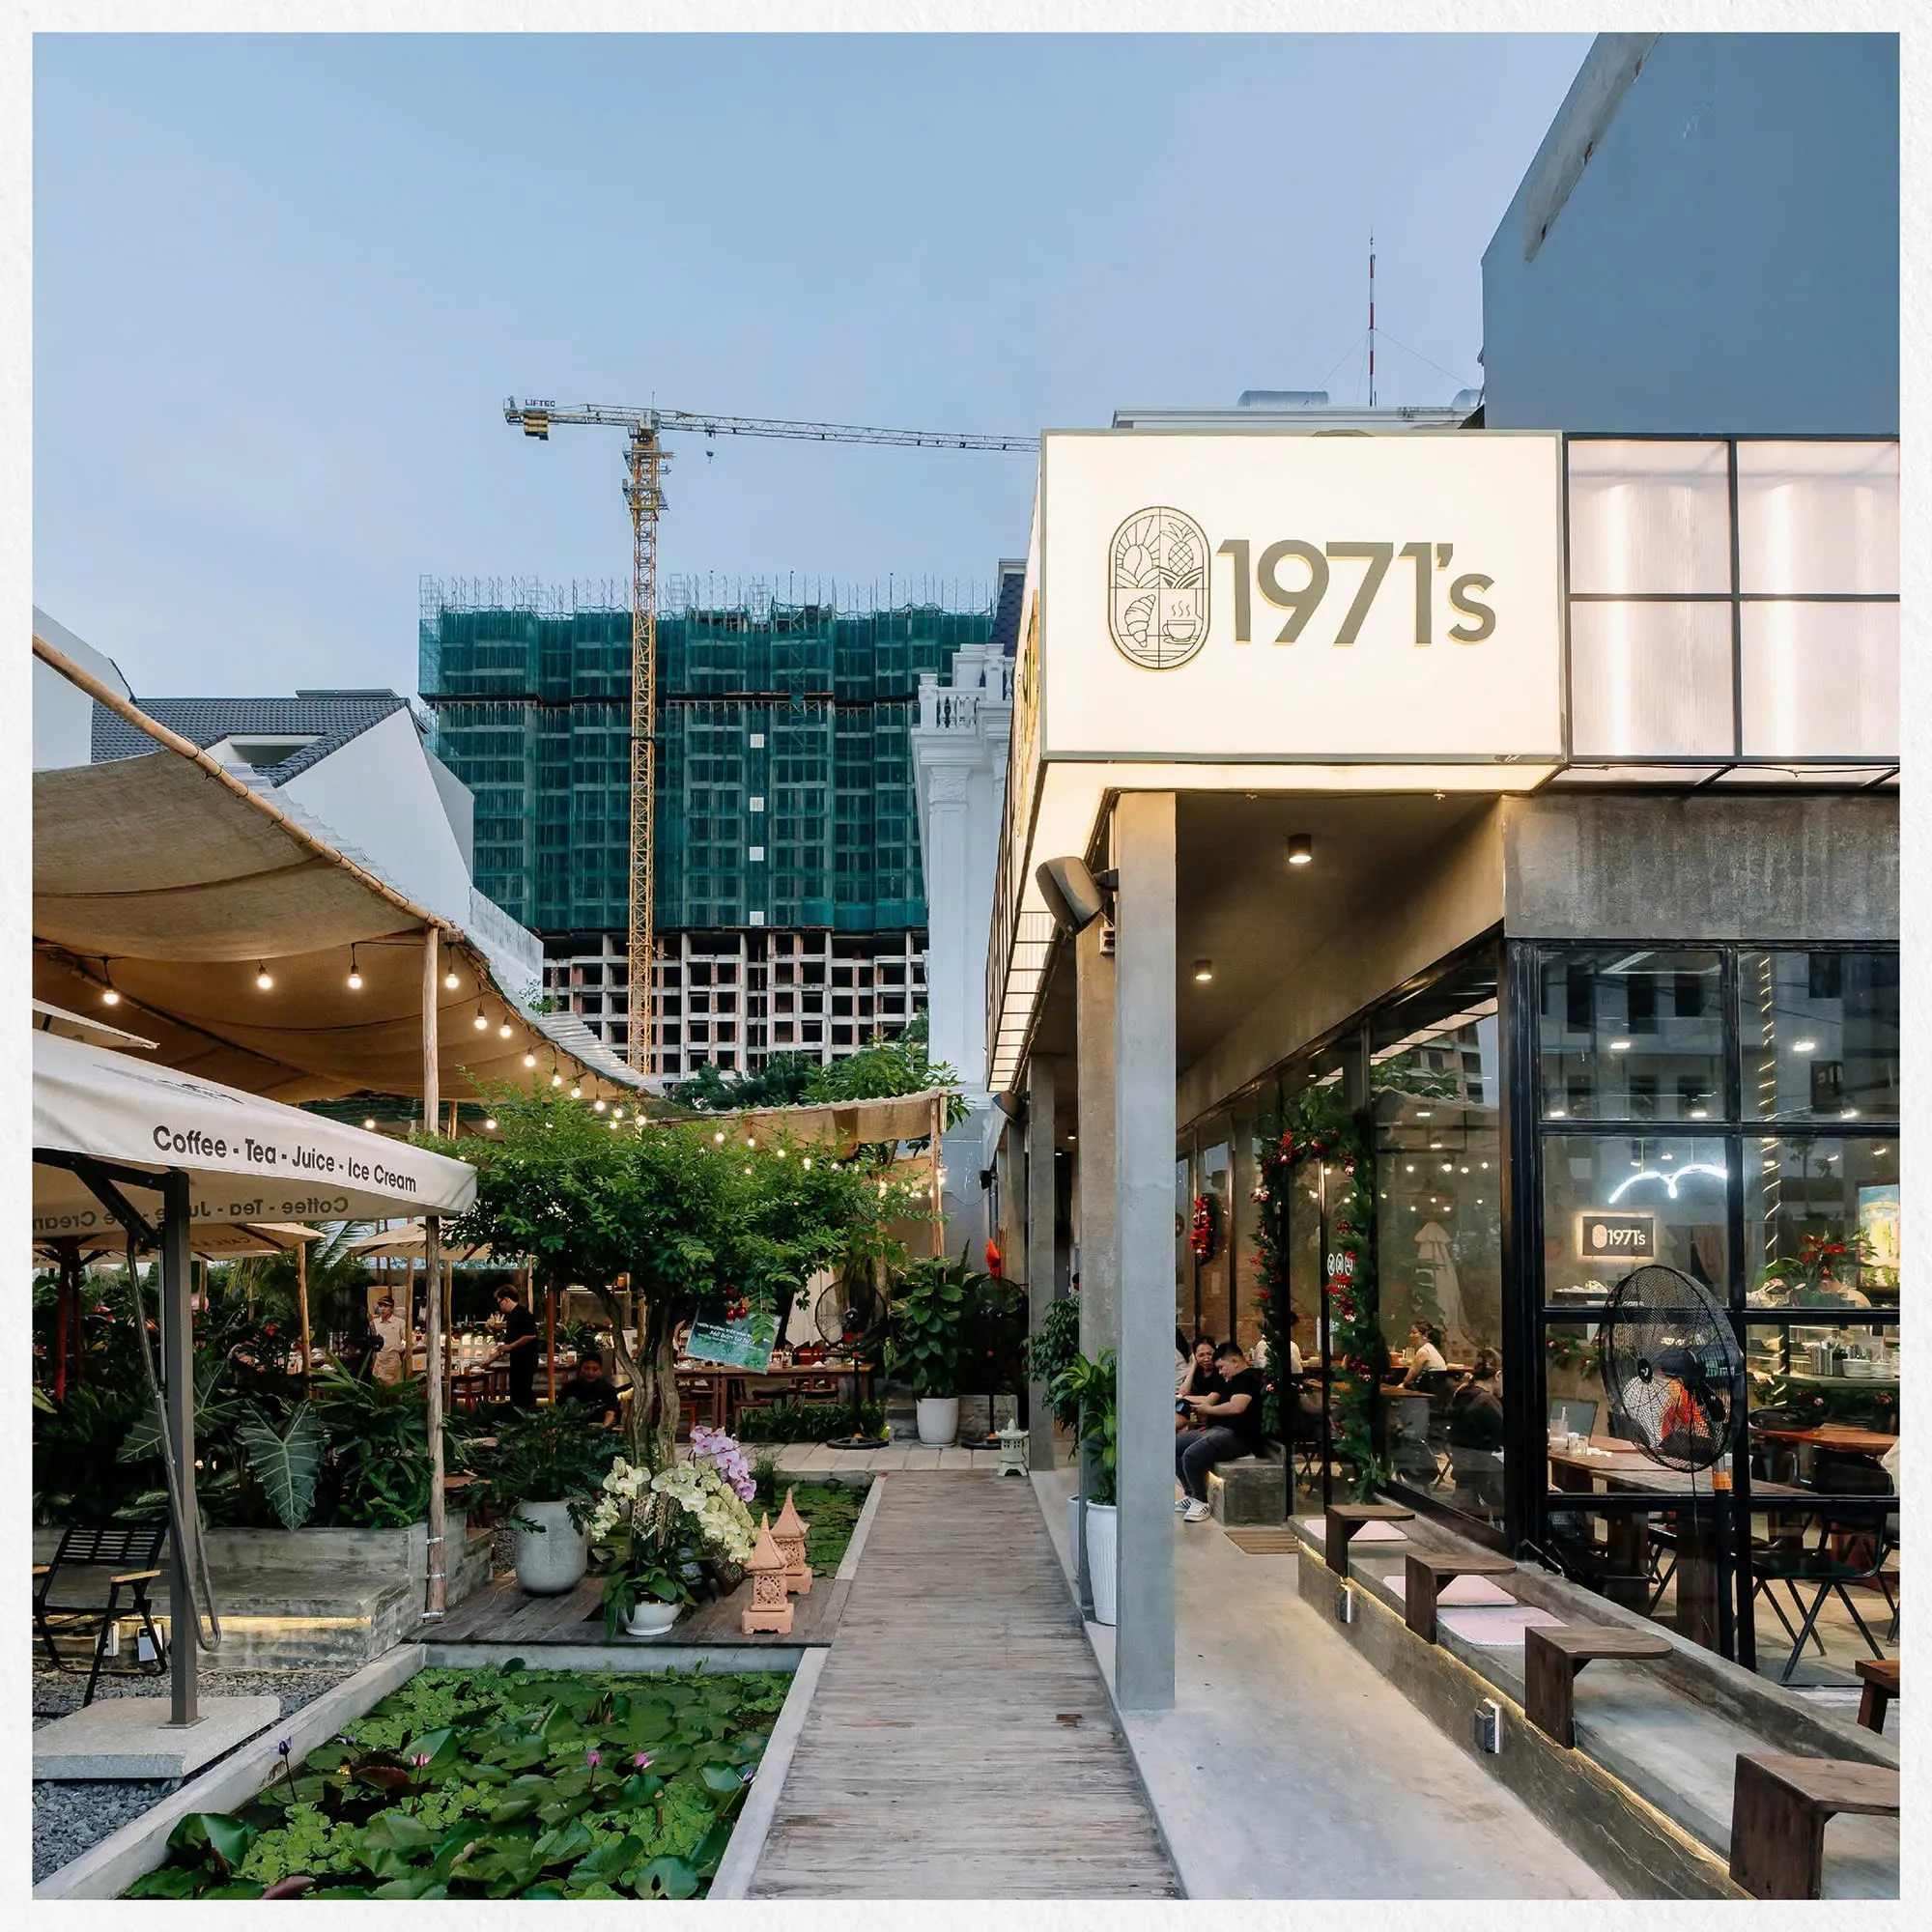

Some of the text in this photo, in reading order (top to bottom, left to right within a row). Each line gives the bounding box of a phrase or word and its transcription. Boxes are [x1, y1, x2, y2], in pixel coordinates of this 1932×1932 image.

[1215, 539, 1496, 646] 1971's
[153, 1125, 227, 1158] Coffee
[244, 1138, 276, 1164] Tea
[292, 1146, 334, 1172] Juice
[348, 1157, 370, 1181] Ice
[374, 1164, 416, 1193] Cream
[1606, 1229, 1646, 1245] 1971's
